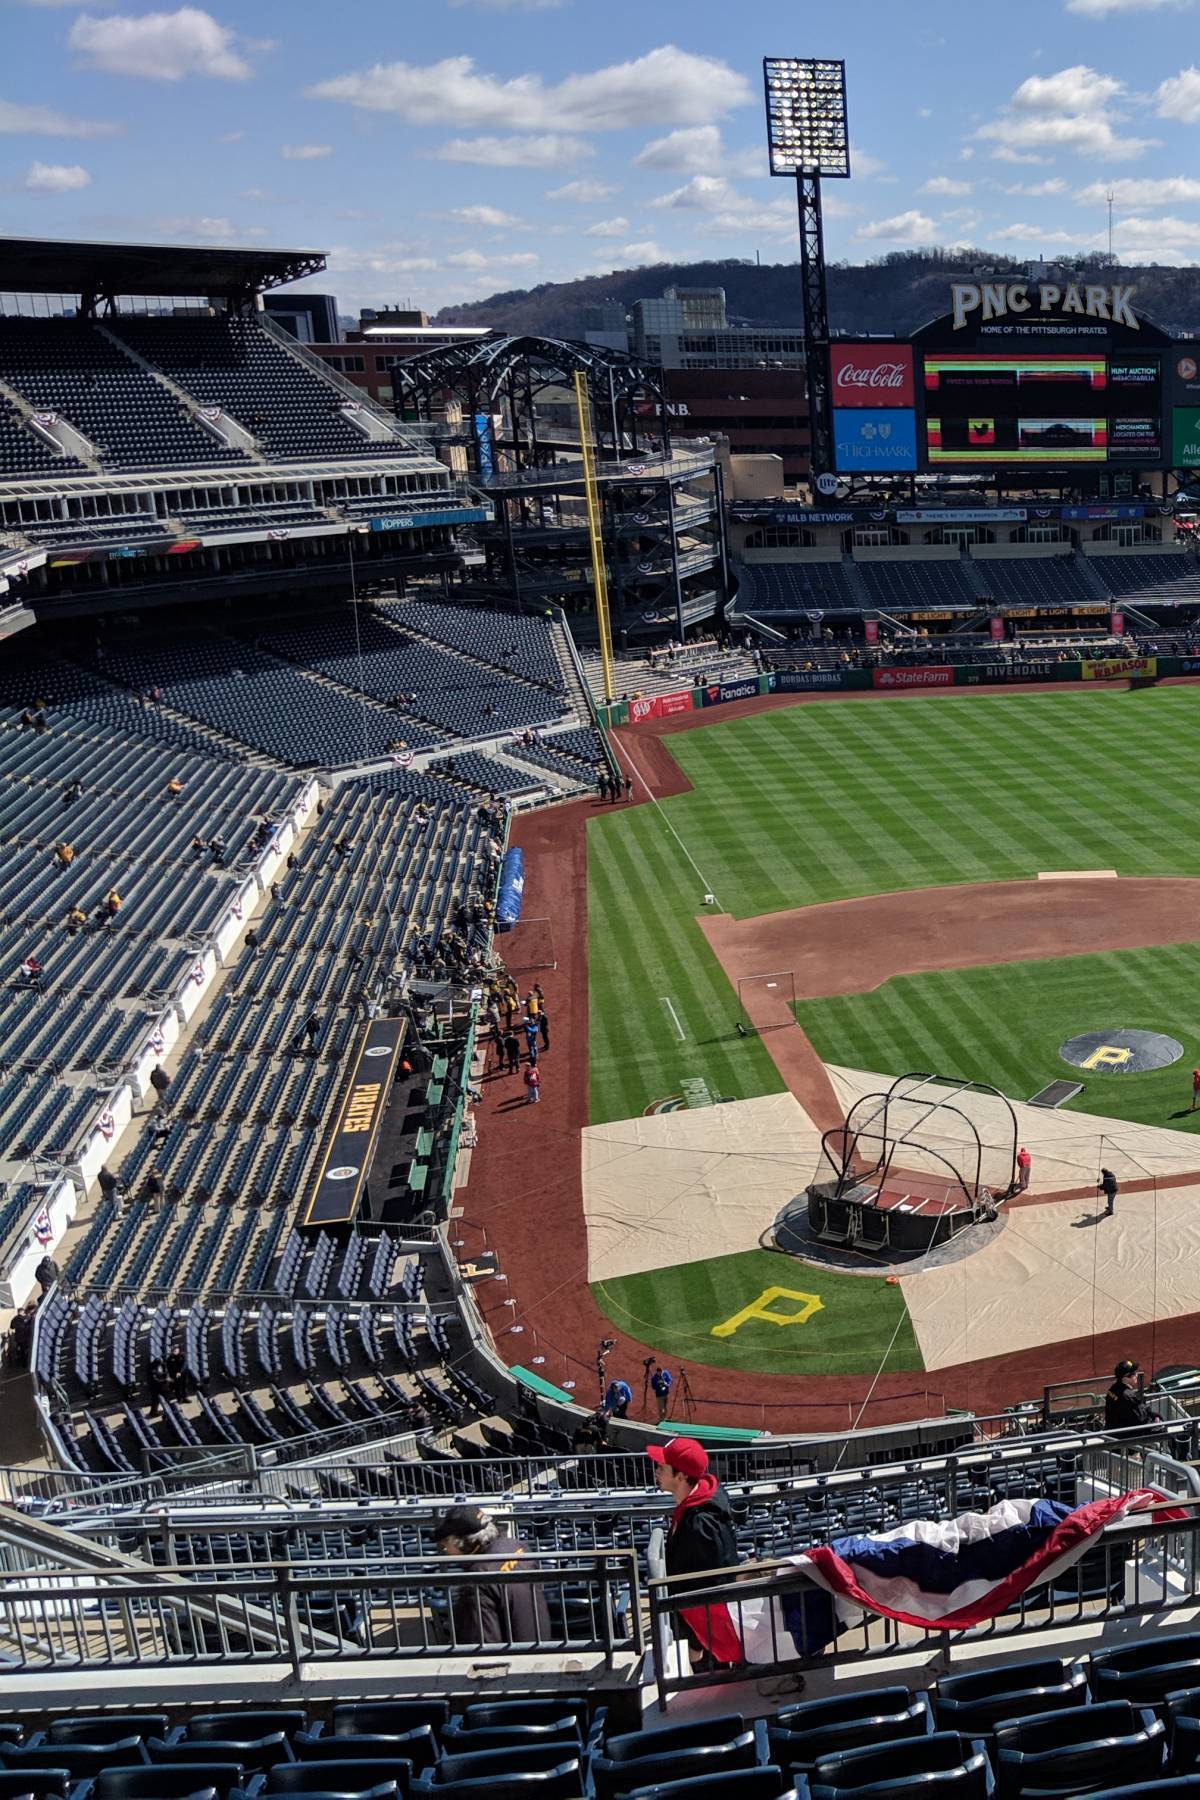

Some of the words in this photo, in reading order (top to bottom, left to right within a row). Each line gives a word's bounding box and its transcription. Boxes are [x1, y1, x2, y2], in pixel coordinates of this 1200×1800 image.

[951, 283, 1032, 331] PNC
[1038, 283, 1141, 331] PARK
[981, 326, 1003, 334] HOME
[1005, 326, 1014, 334] OF
[1015, 326, 1030, 334] THE
[1031, 326, 1077, 335] PITTSBURGH
[1078, 327, 1108, 335] PIRATES
[837, 363, 907, 388] Coca-Cola
[655, 403, 692, 416] FN.B.
[818, 477, 837, 490] Lite
[381, 517, 414, 530] KOPPERS
[787, 512, 807, 523] MLB
[809, 512, 855, 522] NETWORK
[1049, 608, 1069, 616] LIGHT
[781, 675, 809, 684] BORDAS
[813, 673, 841, 682] BORDAS
[896, 671, 923, 683] State
[923, 671, 949, 682] Farm
[720, 684, 756, 700] Fanatics
[1080, 1045, 1134, 1070] P
[342, 1083, 382, 1133] PIRATES
[710, 1285, 826, 1338] P
